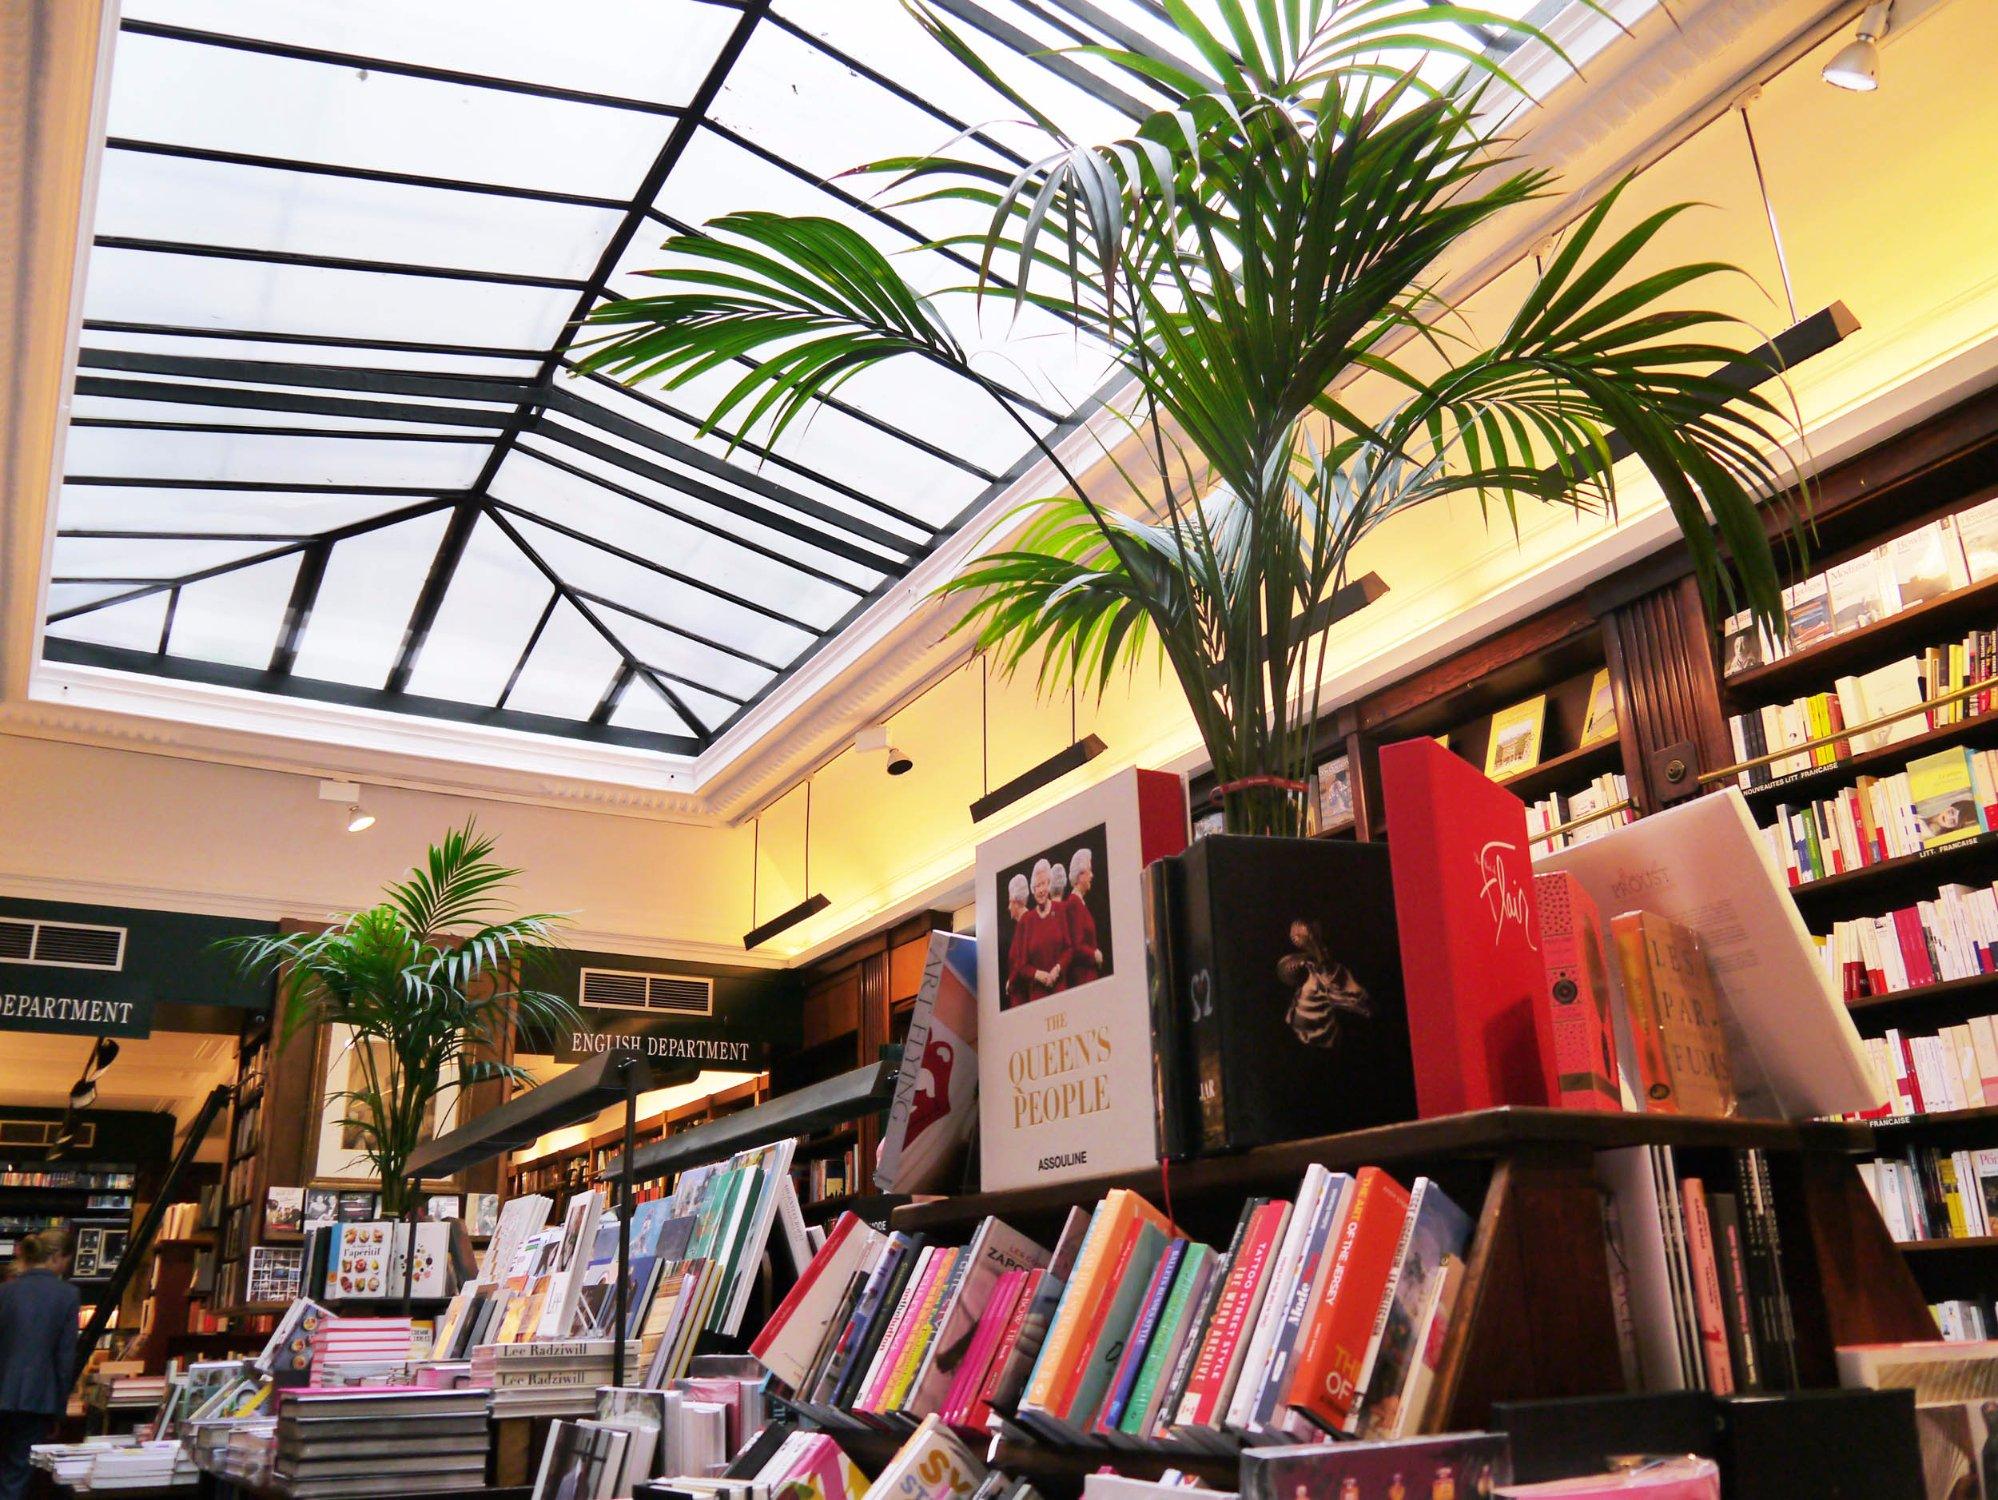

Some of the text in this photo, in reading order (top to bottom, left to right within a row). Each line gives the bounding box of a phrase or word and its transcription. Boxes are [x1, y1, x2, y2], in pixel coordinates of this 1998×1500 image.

[1938, 837, 1979, 854] FRANCAISE
[1479, 841, 1537, 951] Flair
[0, 993, 134, 1024] EPARTMENT
[1043, 1012, 1068, 1032] THE
[571, 1031, 750, 1062] ENGLISH DEPARTMENT
[1007, 1025, 1113, 1096] QUEEN'S
[1010, 1074, 1111, 1130] PEOPLE
[1868, 1116, 1911, 1129] FRANCAISE
[1037, 1149, 1088, 1172] ASSOULINE
[1243, 1240, 1266, 1290] TATTOO
[1324, 1262, 1345, 1305] JERSEY
[1226, 1292, 1248, 1337] STREET
[503, 1342, 587, 1357] Lee Radziwill
[1211, 1339, 1231, 1380] STYLE
[501, 1371, 586, 1386] Lee Radziwill
[1325, 1369, 1354, 1400] OF
